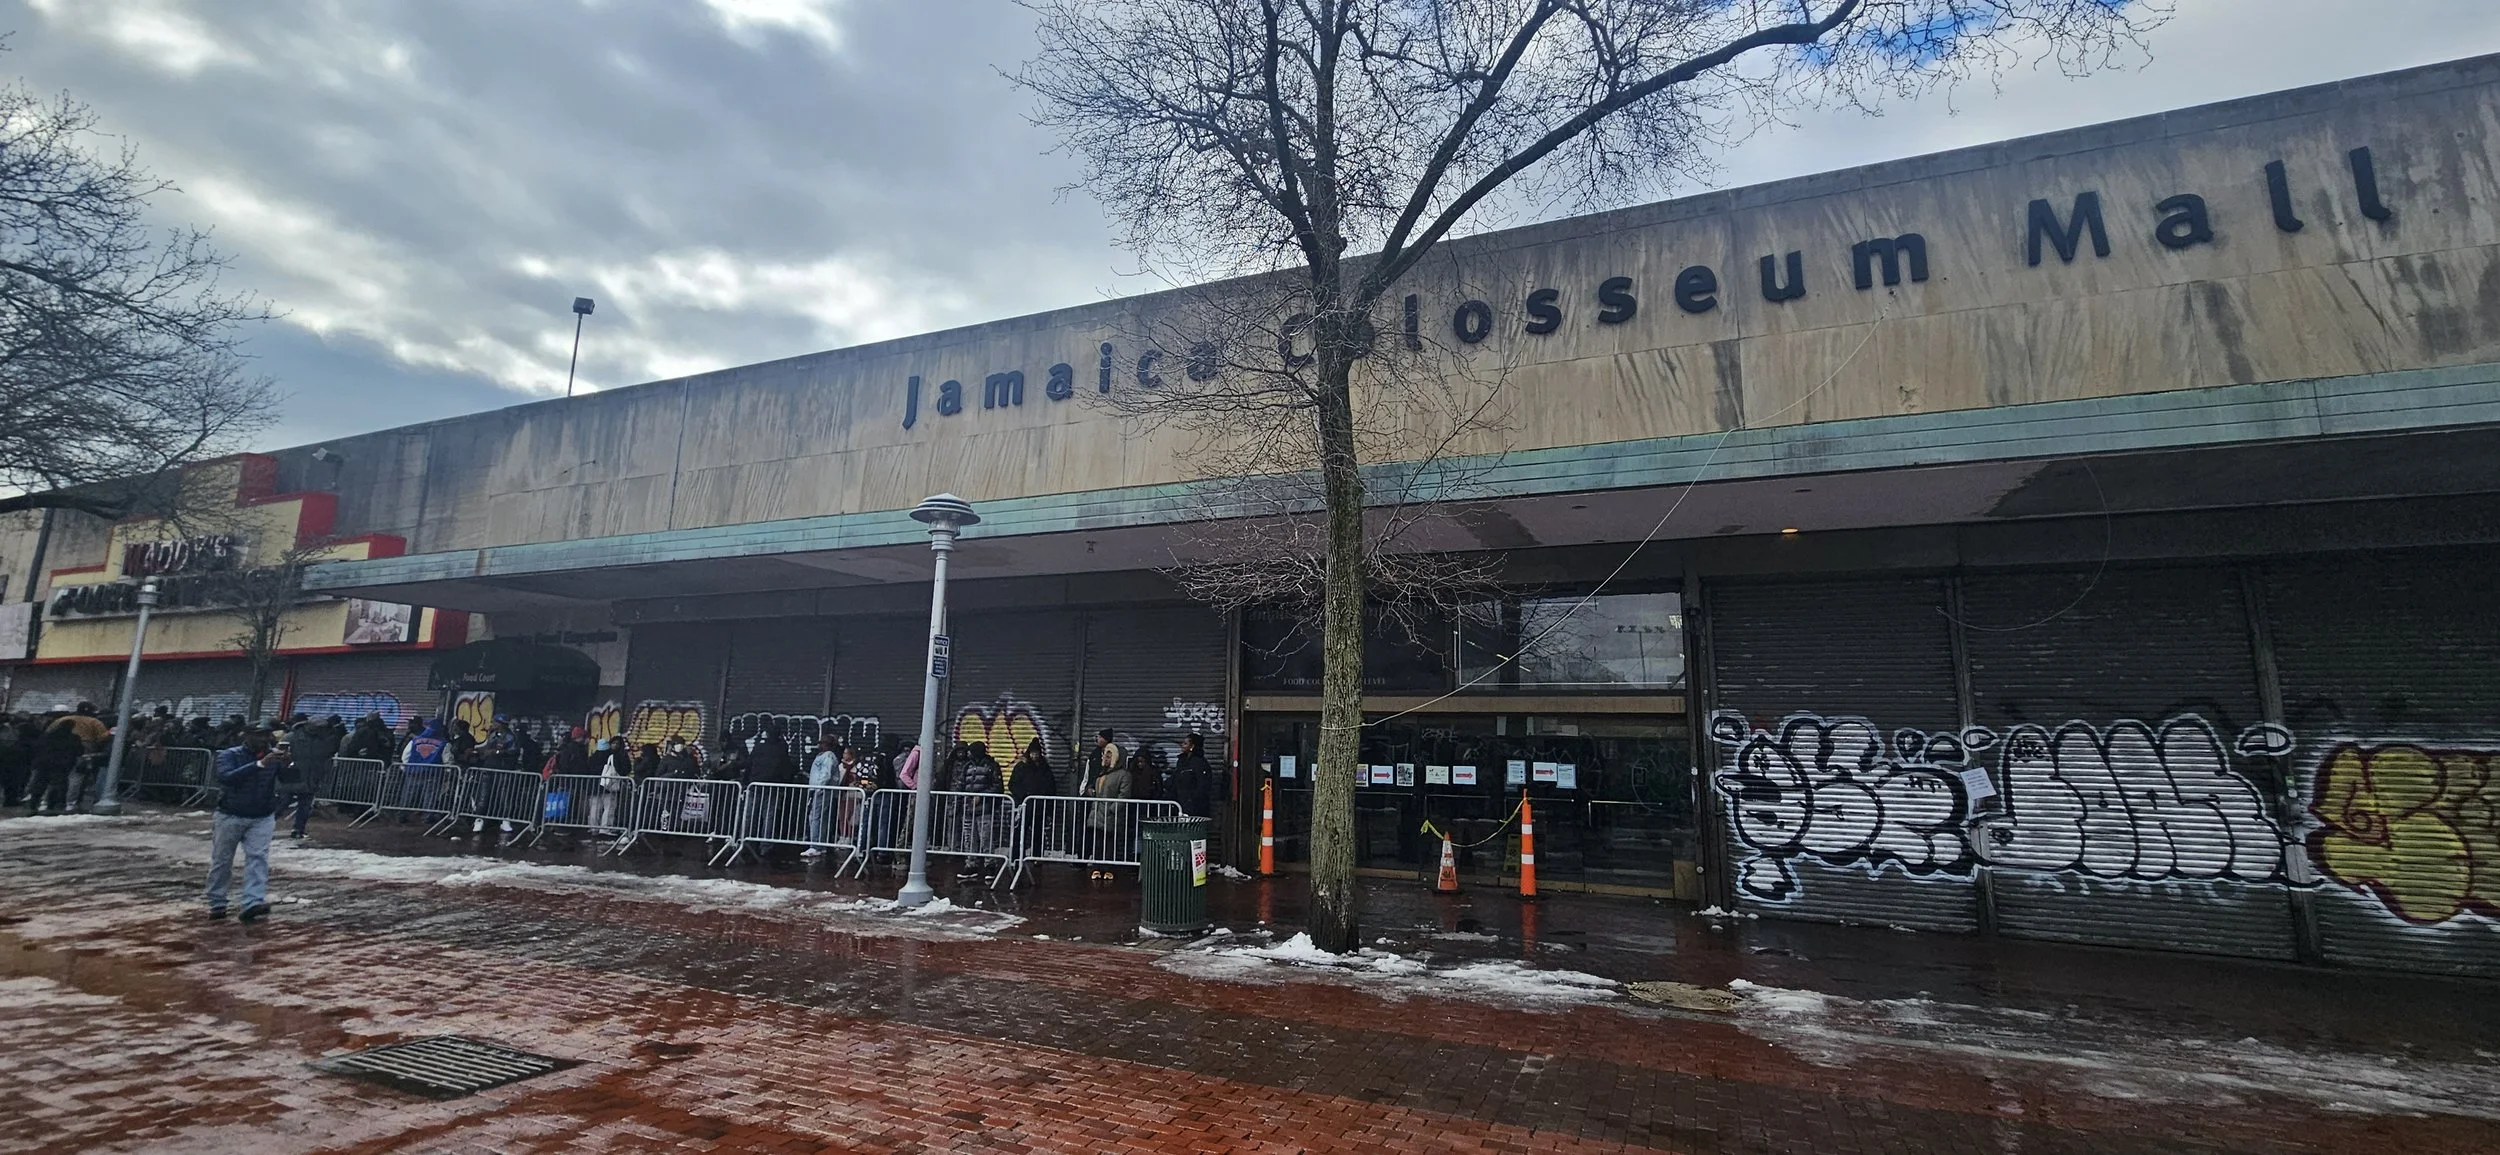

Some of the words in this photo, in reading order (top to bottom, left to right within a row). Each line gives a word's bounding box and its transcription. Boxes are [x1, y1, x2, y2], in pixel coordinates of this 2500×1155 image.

[902, 341, 1218, 431] Jamaica
[1278, 231, 1931, 368] Colosseum
[2027, 145, 2392, 268] Mall
[463, 671, 478, 683] Food
[479, 671, 497, 683] Court
